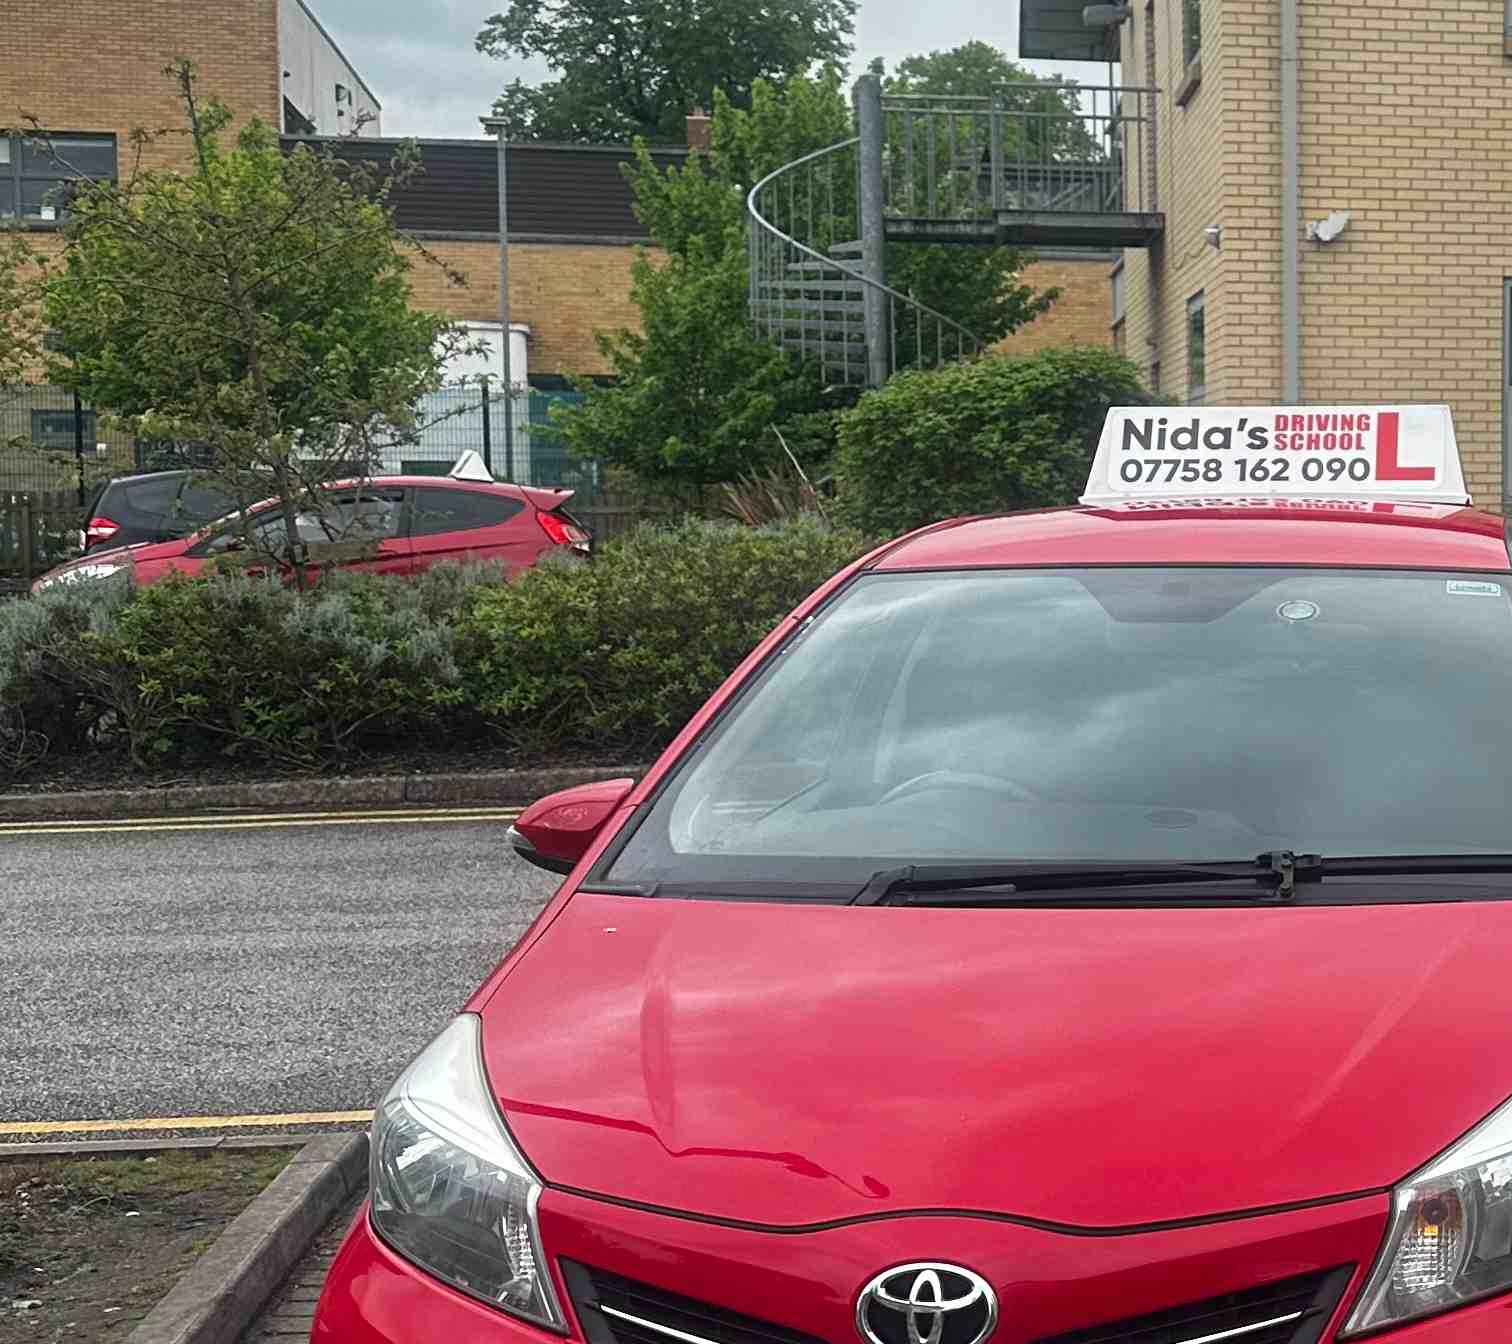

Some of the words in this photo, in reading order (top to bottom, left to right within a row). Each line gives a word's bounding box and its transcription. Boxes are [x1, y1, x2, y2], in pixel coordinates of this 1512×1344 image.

[1121, 417, 1270, 451] Nida's
[1274, 413, 1371, 432] DRIVING
[1274, 432, 1366, 451] SCHOOL
[1374, 411, 1436, 481] L
[1120, 457, 1223, 483] 07758
[1234, 457, 1290, 482] 162
[1301, 457, 1371, 482] 090
